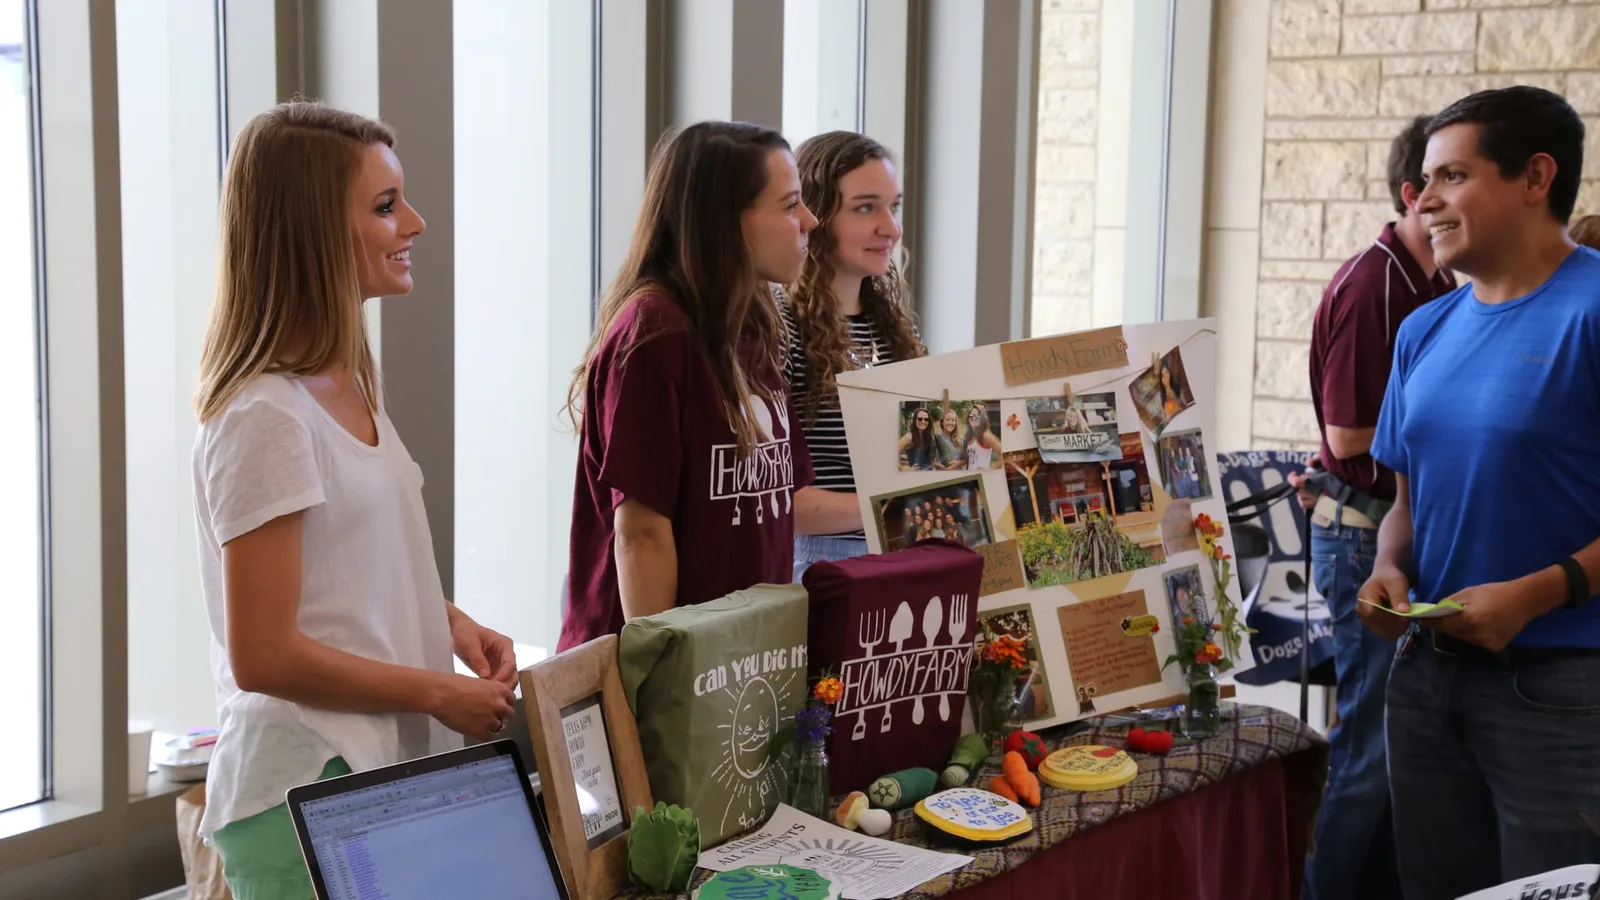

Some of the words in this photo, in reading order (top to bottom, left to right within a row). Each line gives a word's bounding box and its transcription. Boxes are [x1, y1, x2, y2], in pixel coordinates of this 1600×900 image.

[1006, 347, 1071, 380] Howdy
[1063, 433, 1104, 448] MARKET
[1258, 636, 1303, 664] Dogs
[842, 647, 973, 711] HOWDYFARM
[717, 832, 773, 853] CALLING
[718, 854, 746, 866] ALL
[741, 823, 806, 855] STUDENTS
